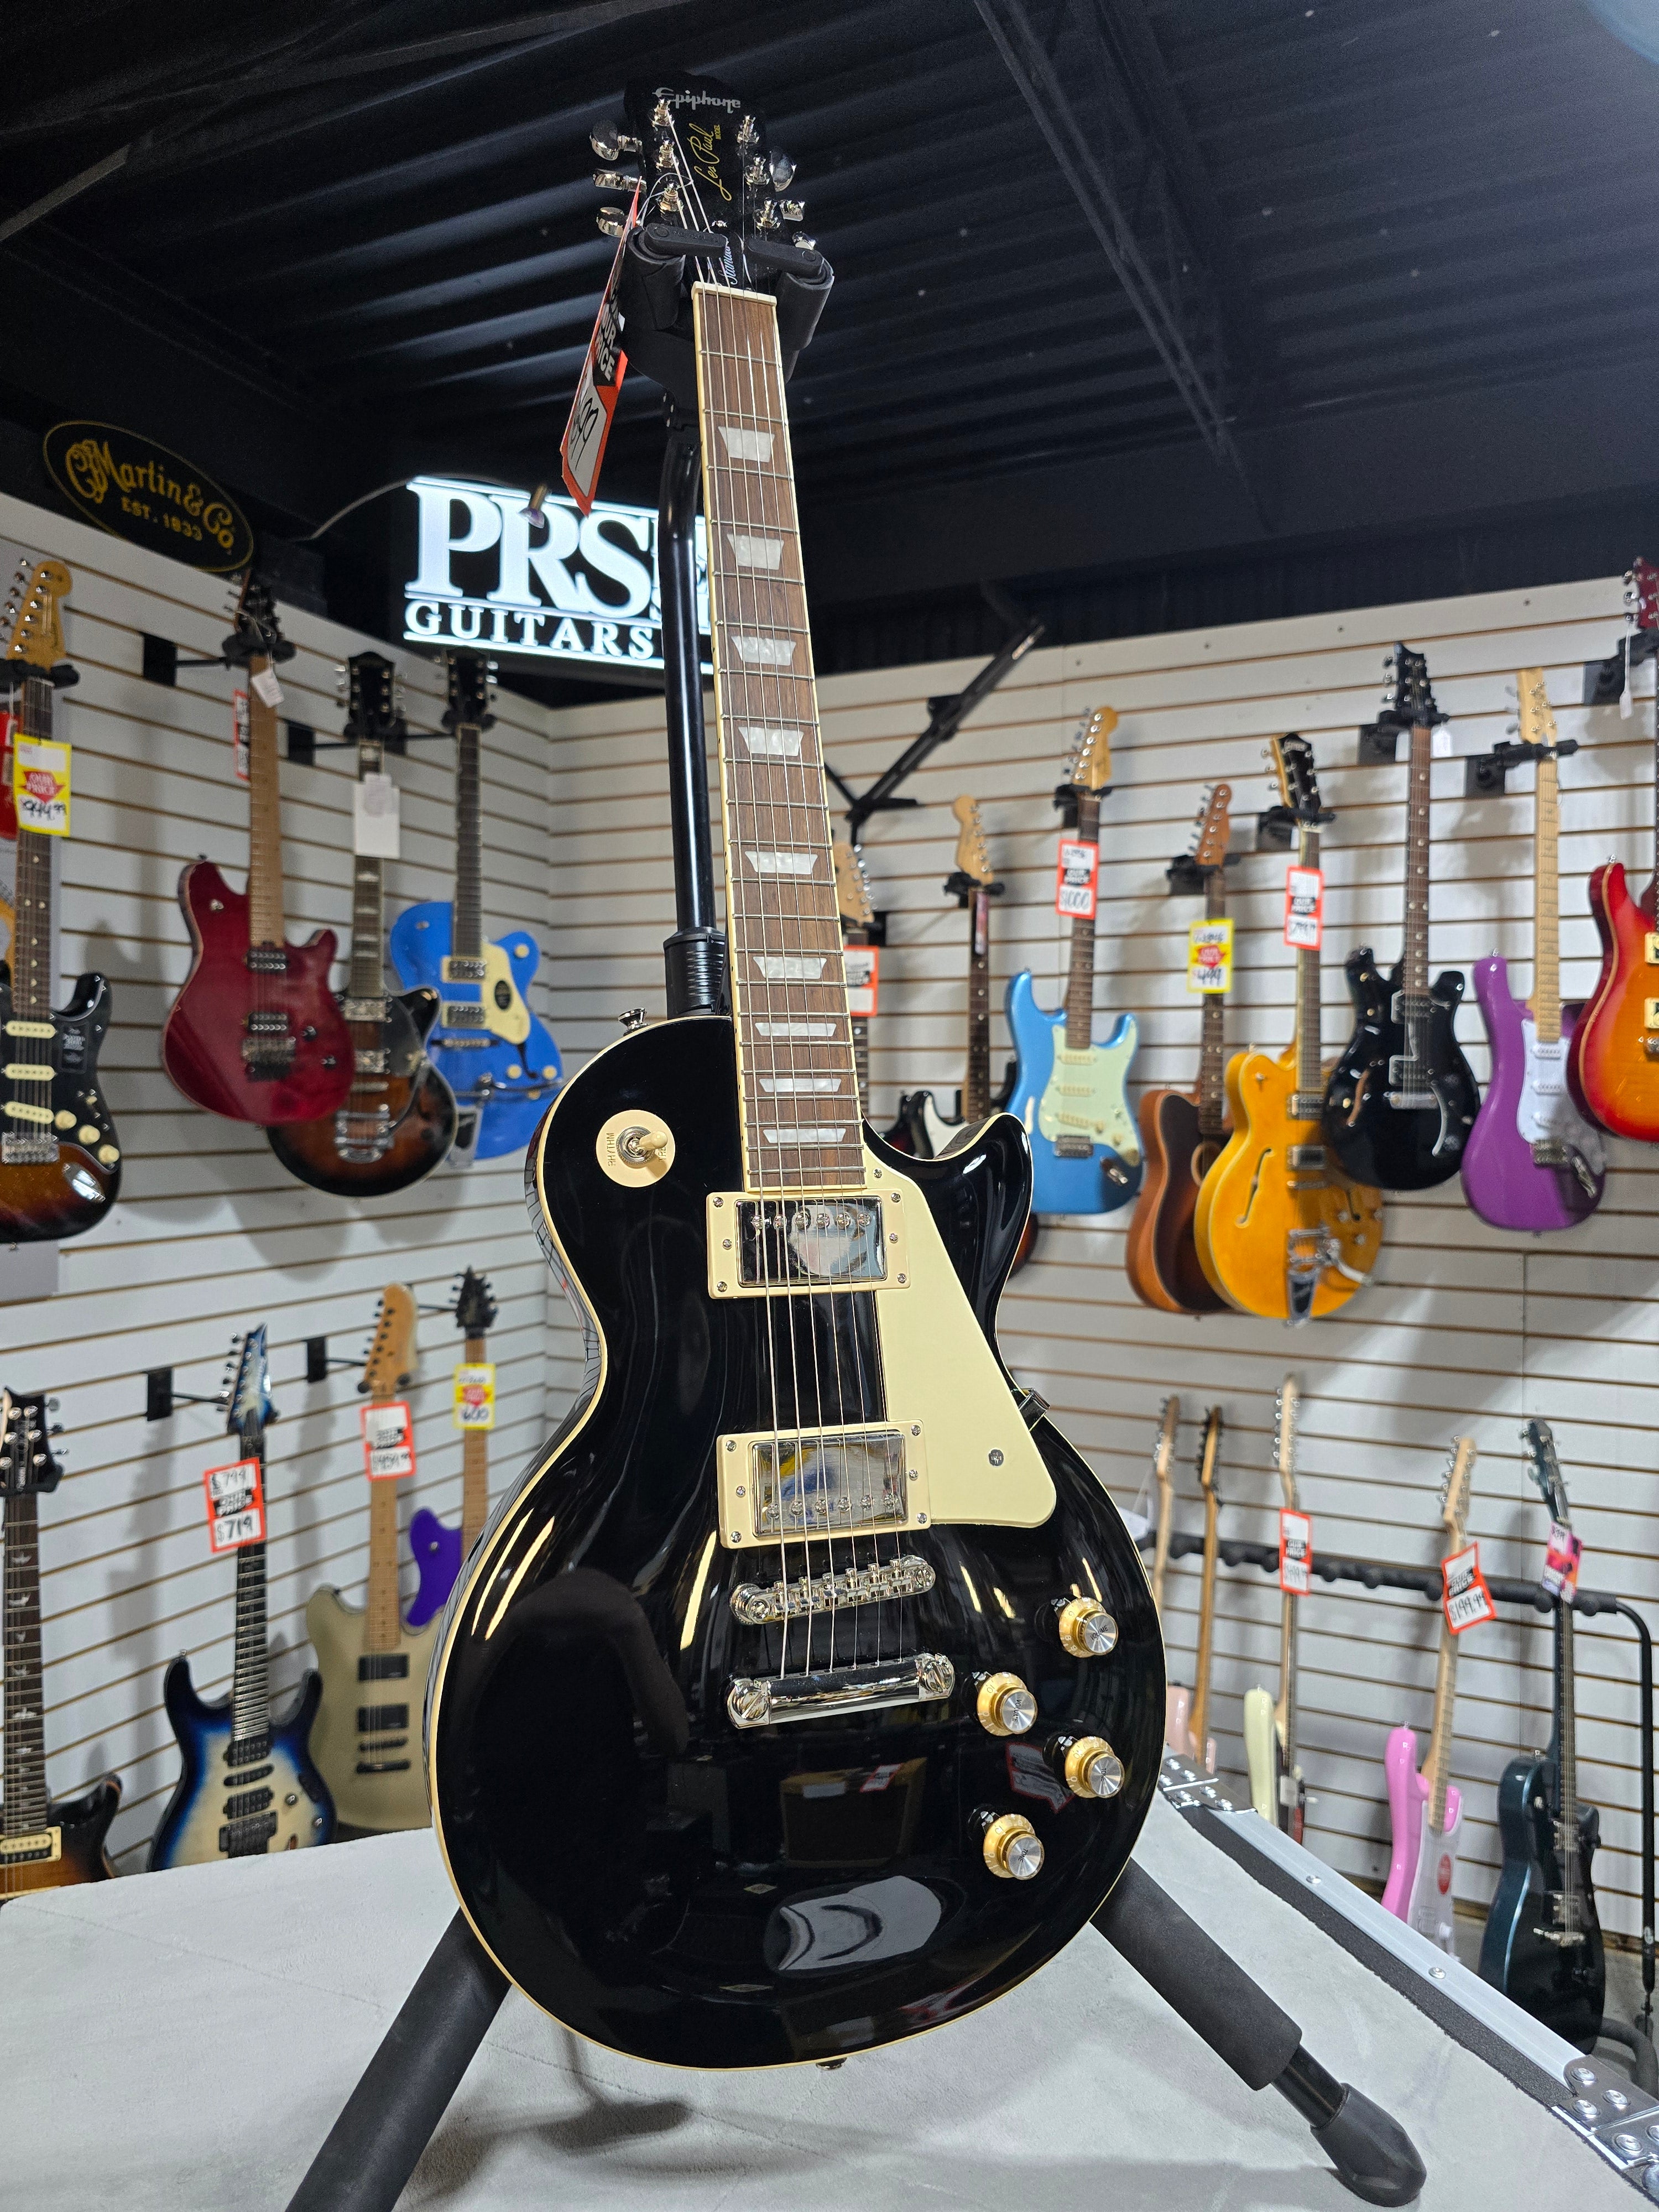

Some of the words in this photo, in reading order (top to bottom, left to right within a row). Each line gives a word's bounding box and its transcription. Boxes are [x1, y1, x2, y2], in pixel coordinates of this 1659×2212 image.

[652, 87, 742, 114] Epiphone
[686, 123, 720, 164] Paul
[405, 478, 651, 618] PRS
[404, 599, 654, 660] GUITARS
[606, 1132, 616, 1167] RHYTHM
[1089, 1625, 1109, 1641] VOLUME
[1012, 1699, 1022, 1723] VOLUME
[1018, 1848, 1029, 1863] TONE
